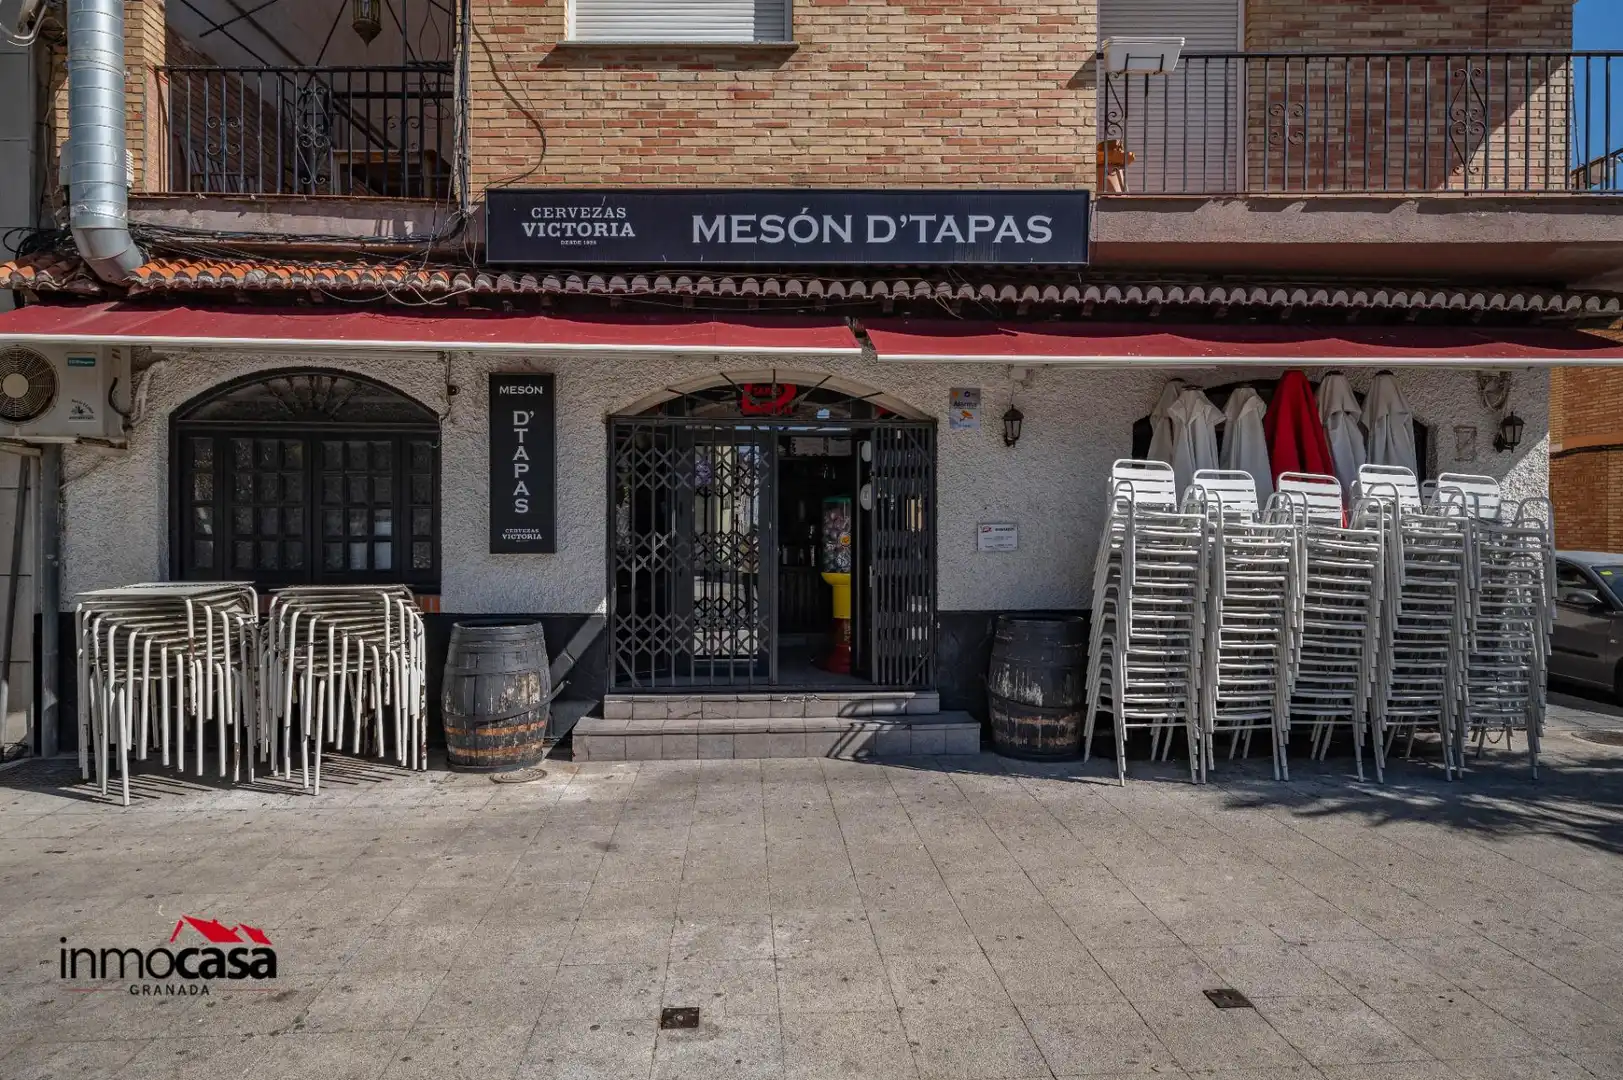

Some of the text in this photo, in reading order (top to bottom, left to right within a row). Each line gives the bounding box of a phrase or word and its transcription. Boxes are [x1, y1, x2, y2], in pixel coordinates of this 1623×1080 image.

[531, 207, 627, 219] CERVEZAS
[521, 222, 636, 237] VICTORIA
[692, 207, 1053, 244] MESÓN D'TAPAS
[499, 384, 543, 395] MESÓN
